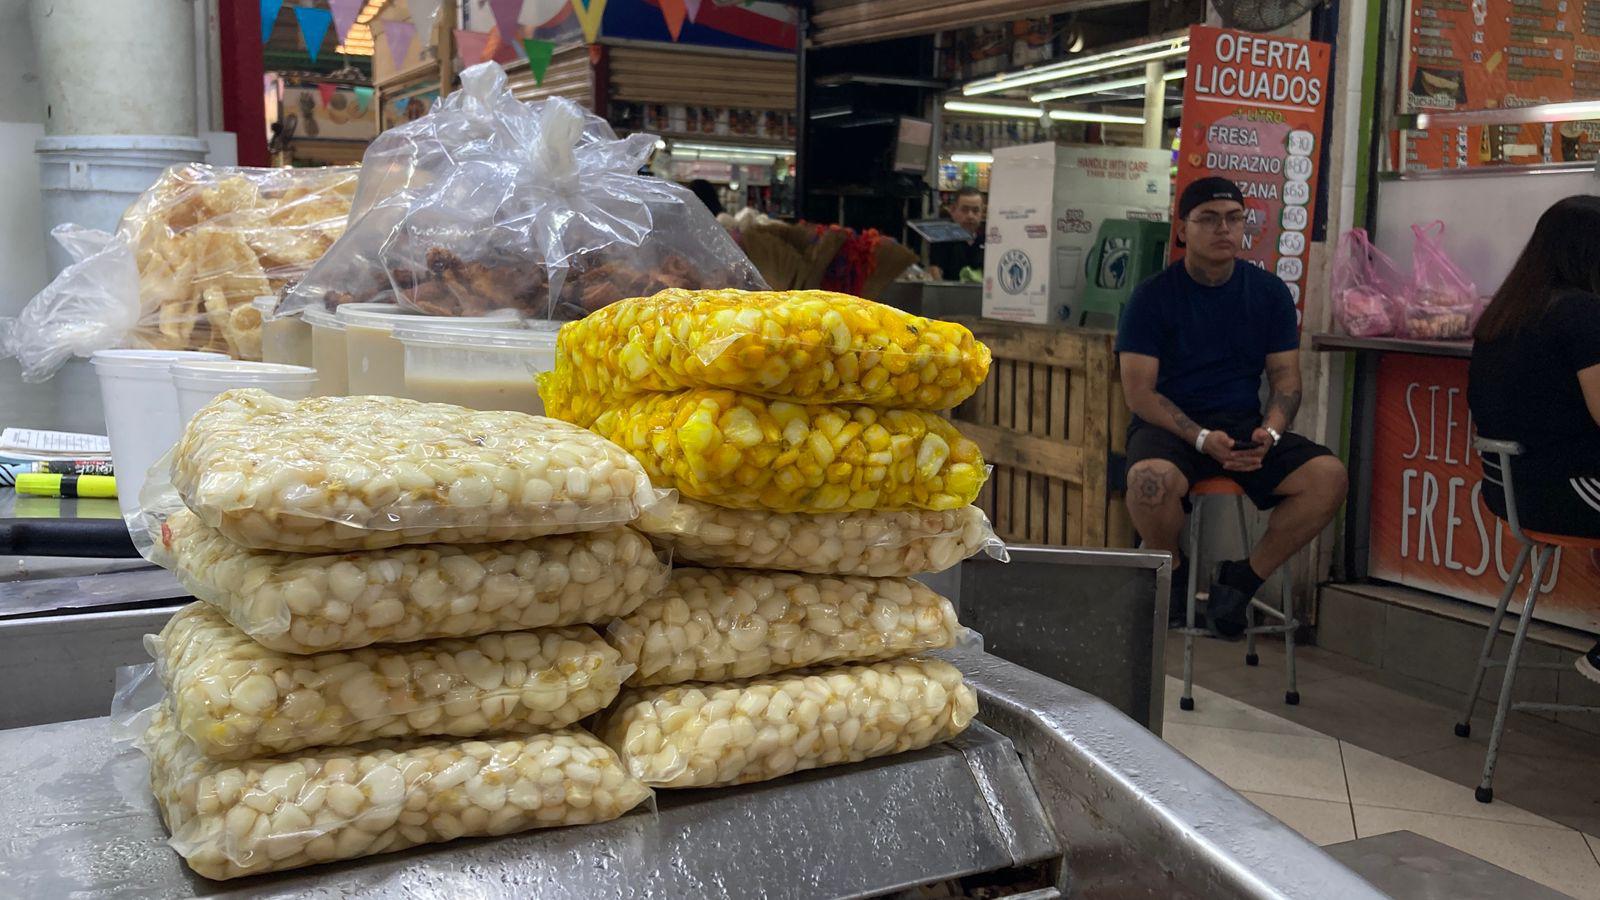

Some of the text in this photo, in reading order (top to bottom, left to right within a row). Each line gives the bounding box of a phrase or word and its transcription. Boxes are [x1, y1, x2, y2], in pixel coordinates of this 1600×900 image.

[1216, 33, 1311, 73] OFERTA
[1194, 64, 1321, 106] LICUADOS
[1207, 126, 1258, 146] FRESA
[1206, 152, 1281, 174] DURAZNO
[1236, 181, 1278, 200] ZANA
[1403, 382, 1480, 466] SIE
